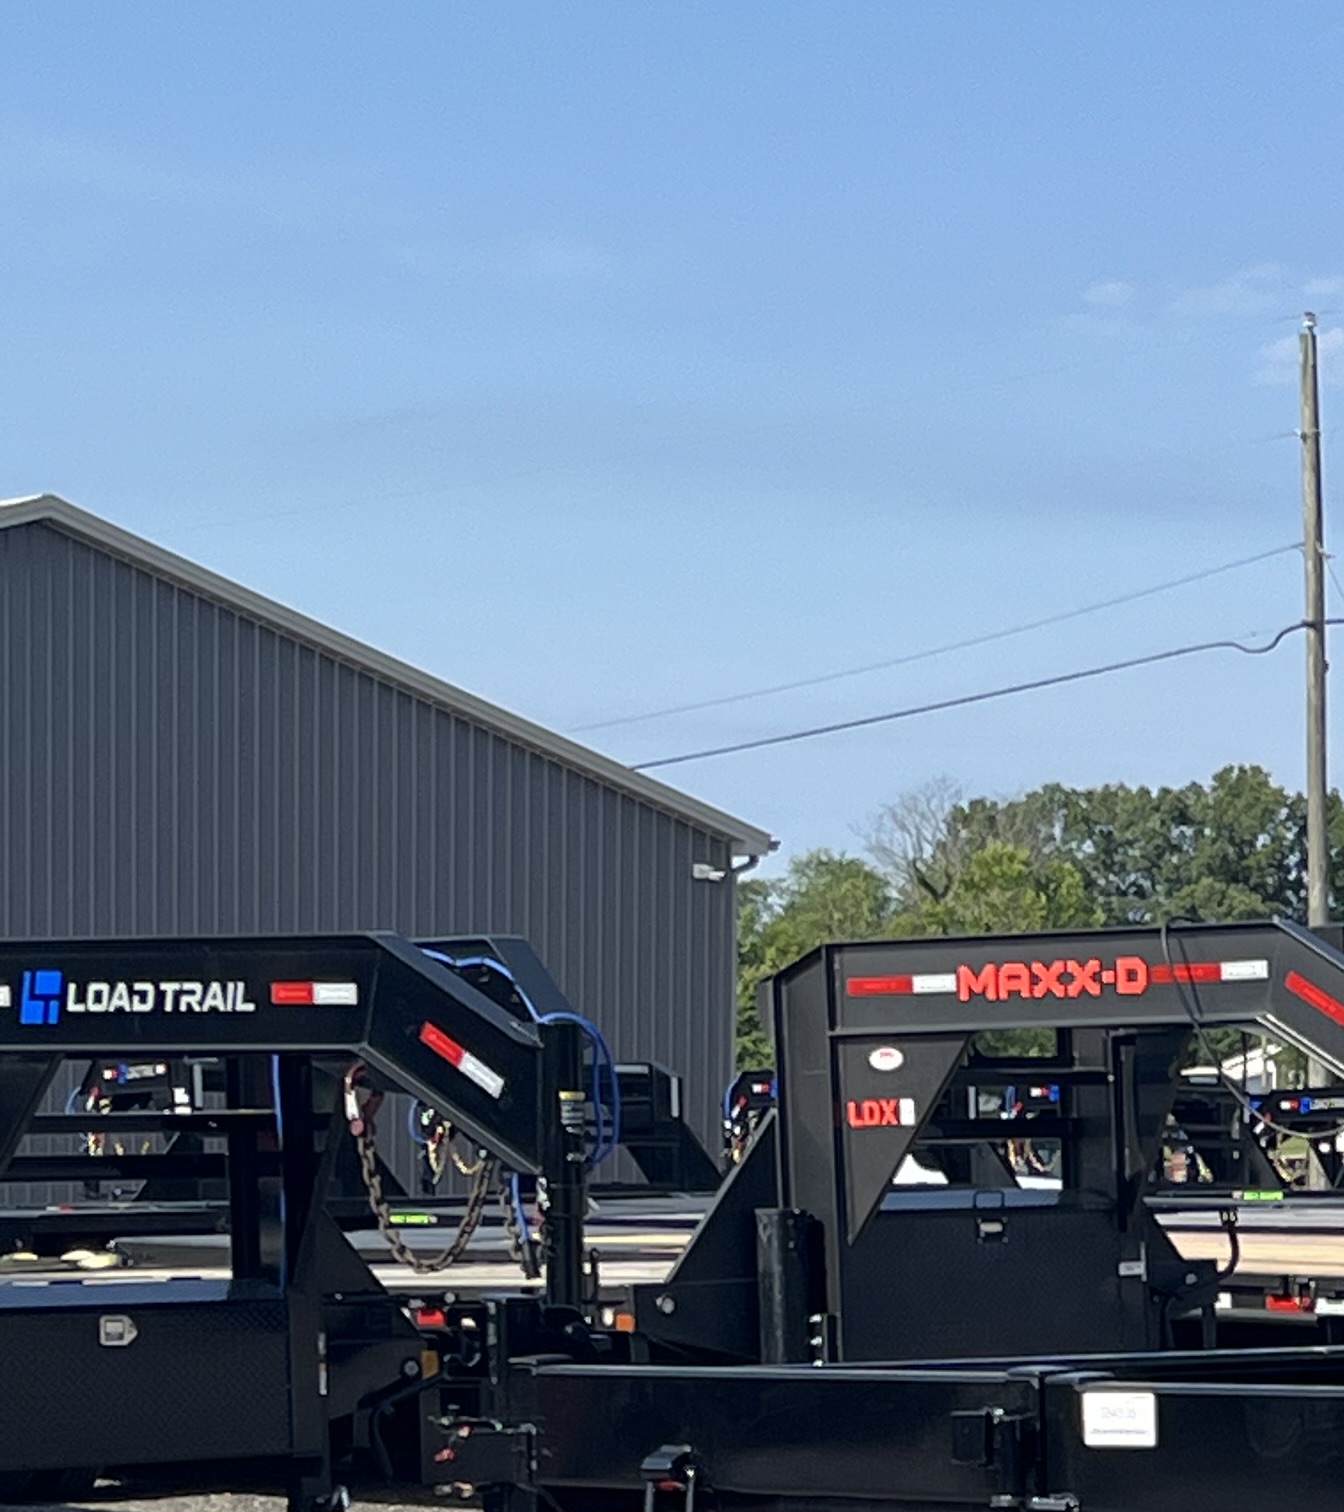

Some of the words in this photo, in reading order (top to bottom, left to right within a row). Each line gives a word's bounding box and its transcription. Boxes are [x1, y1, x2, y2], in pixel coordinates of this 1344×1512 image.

[956, 955, 1149, 1002] MAXX-D
[66, 981, 155, 1012] LOAD
[159, 981, 256, 1012] TRAIL
[847, 1098, 899, 1129] LDX
